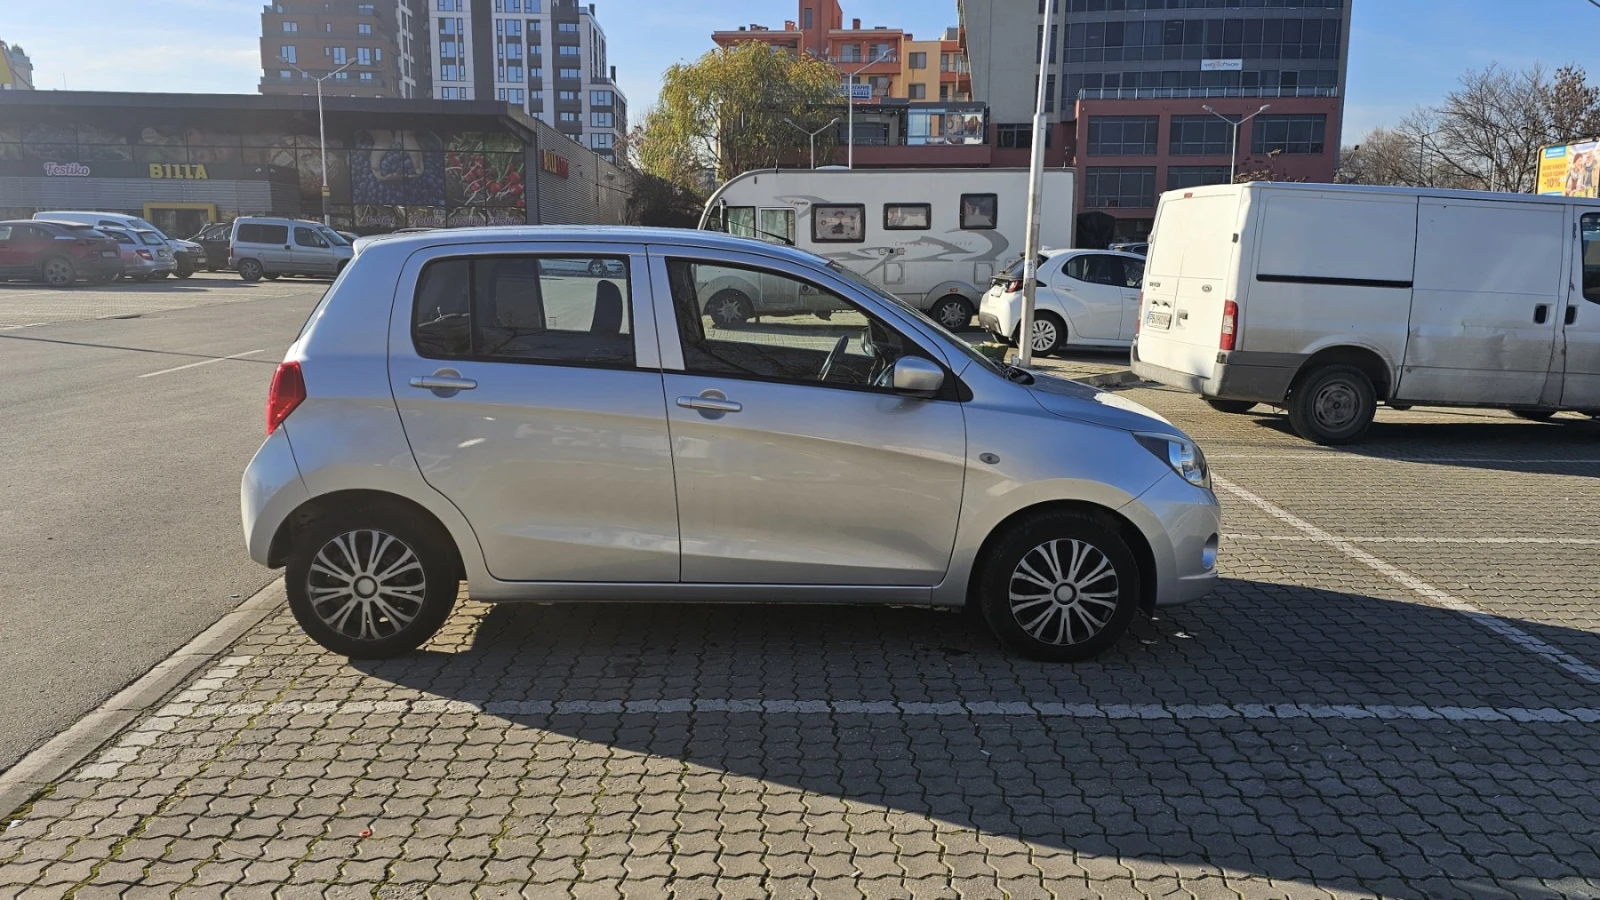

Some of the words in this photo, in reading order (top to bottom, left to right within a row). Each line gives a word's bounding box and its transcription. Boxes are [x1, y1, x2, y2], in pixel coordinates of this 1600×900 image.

[44, 162, 90, 176] Festiko
[150, 163, 208, 179] BILLA
[1544, 177, 1561, 188] -10%
